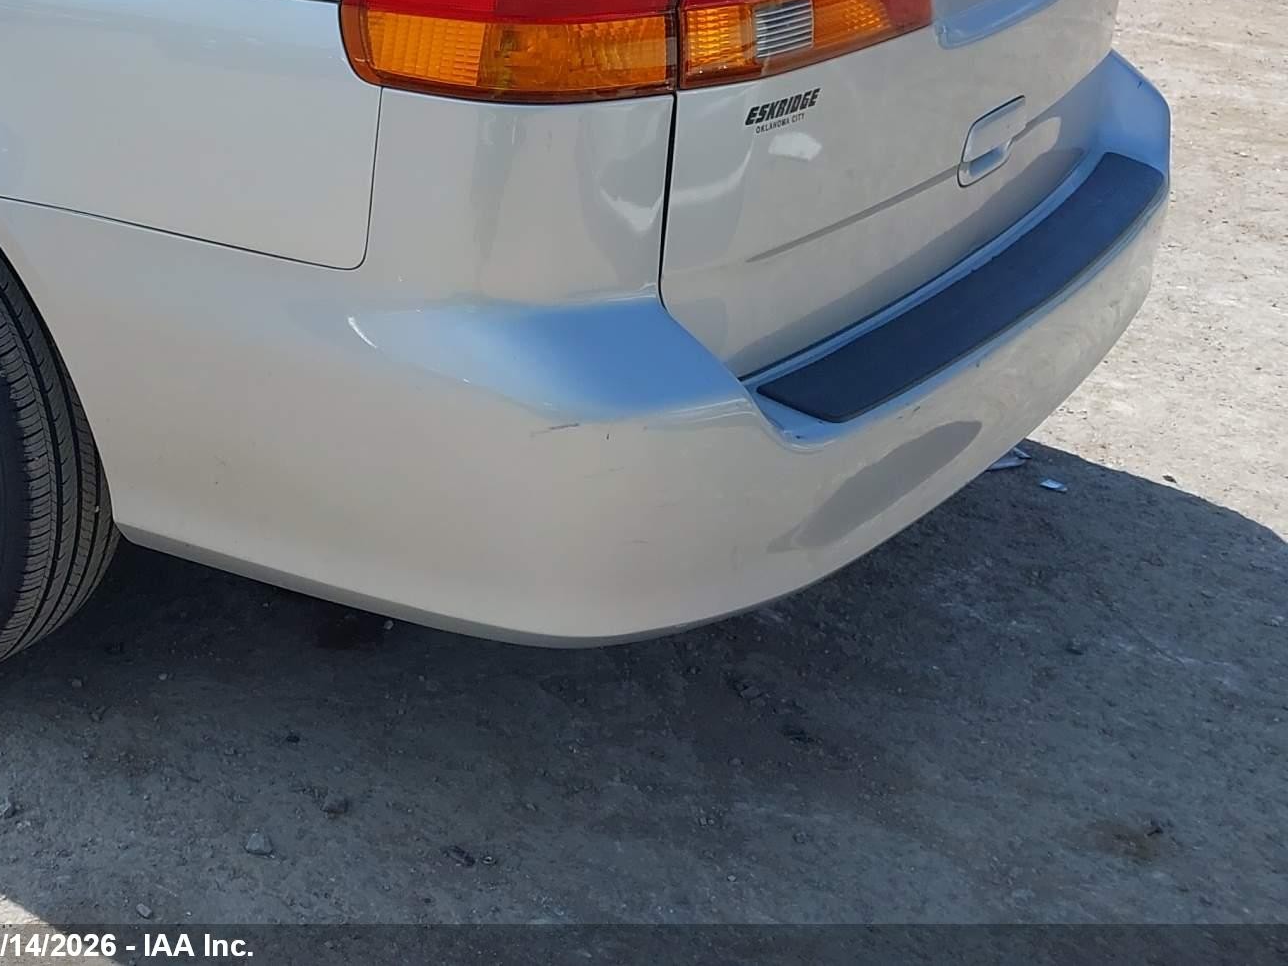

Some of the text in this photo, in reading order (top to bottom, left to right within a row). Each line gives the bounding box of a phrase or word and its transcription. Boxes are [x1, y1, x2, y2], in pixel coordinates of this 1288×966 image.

[745, 88, 821, 126] ESKRIDGE
[755, 113, 805, 134] OKLAHOMA CITY
